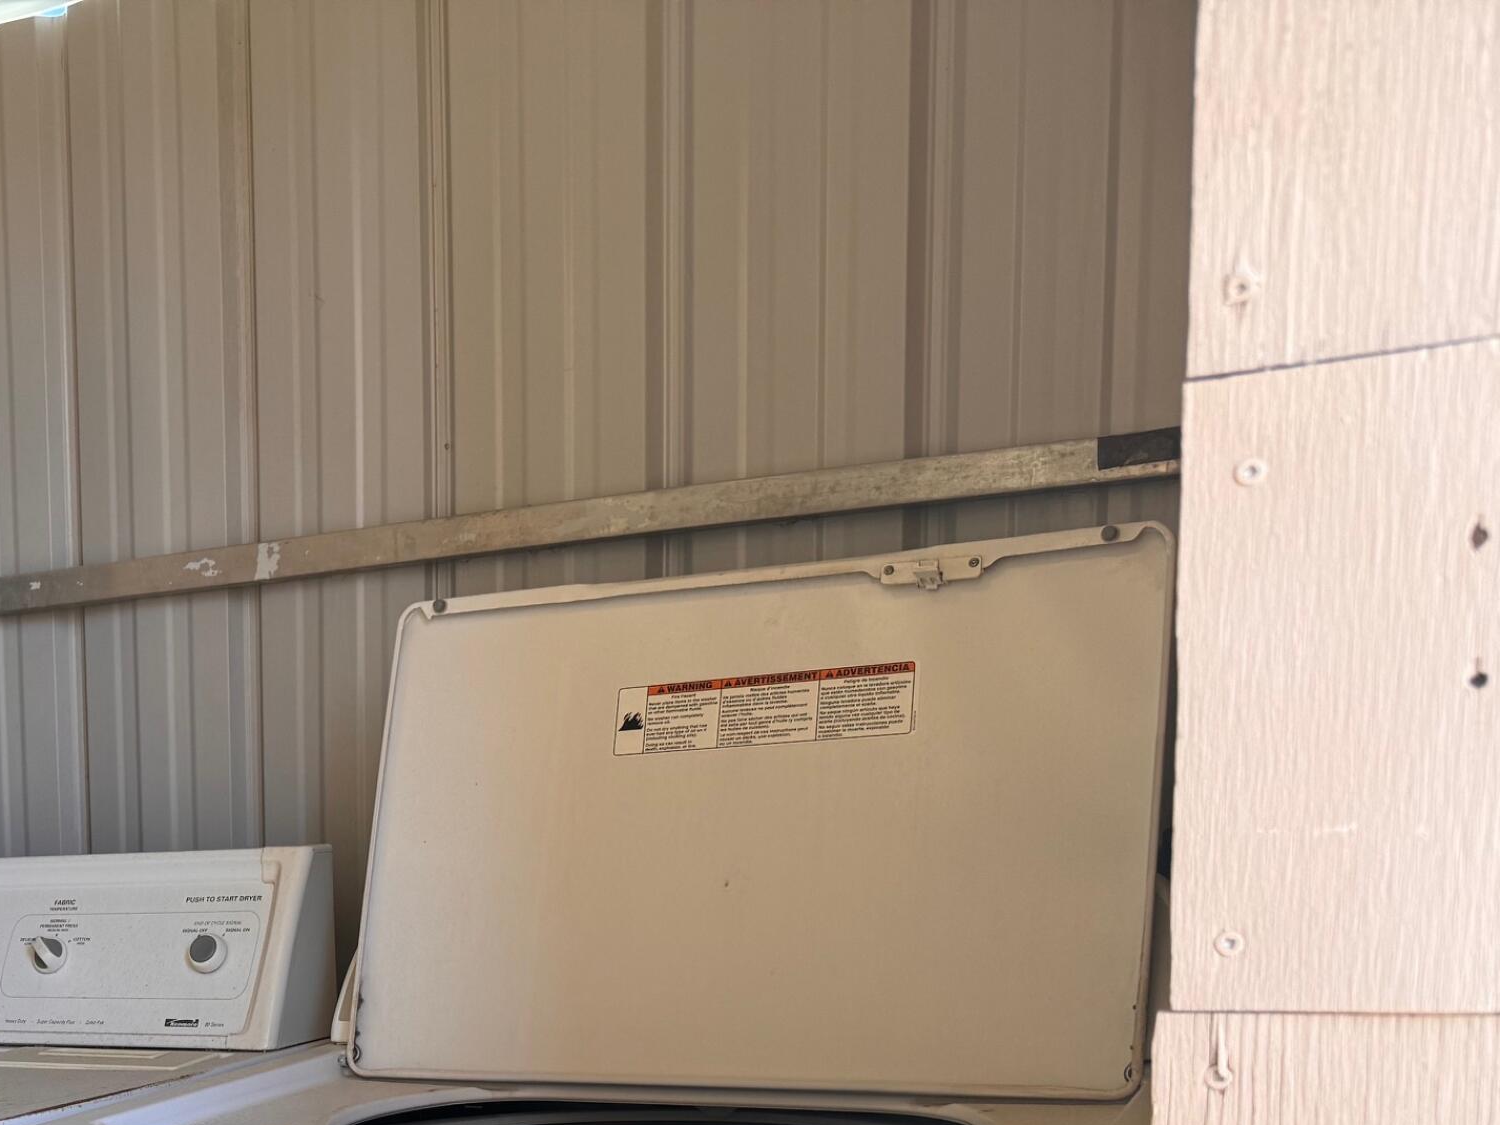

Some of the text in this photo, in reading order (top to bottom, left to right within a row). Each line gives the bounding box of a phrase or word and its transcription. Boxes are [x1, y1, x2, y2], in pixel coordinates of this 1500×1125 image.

[836, 664, 910, 677] ADVERTENCIA
[734, 672, 818, 686] AVERTISSEMENT
[667, 682, 712, 692] WARNING
